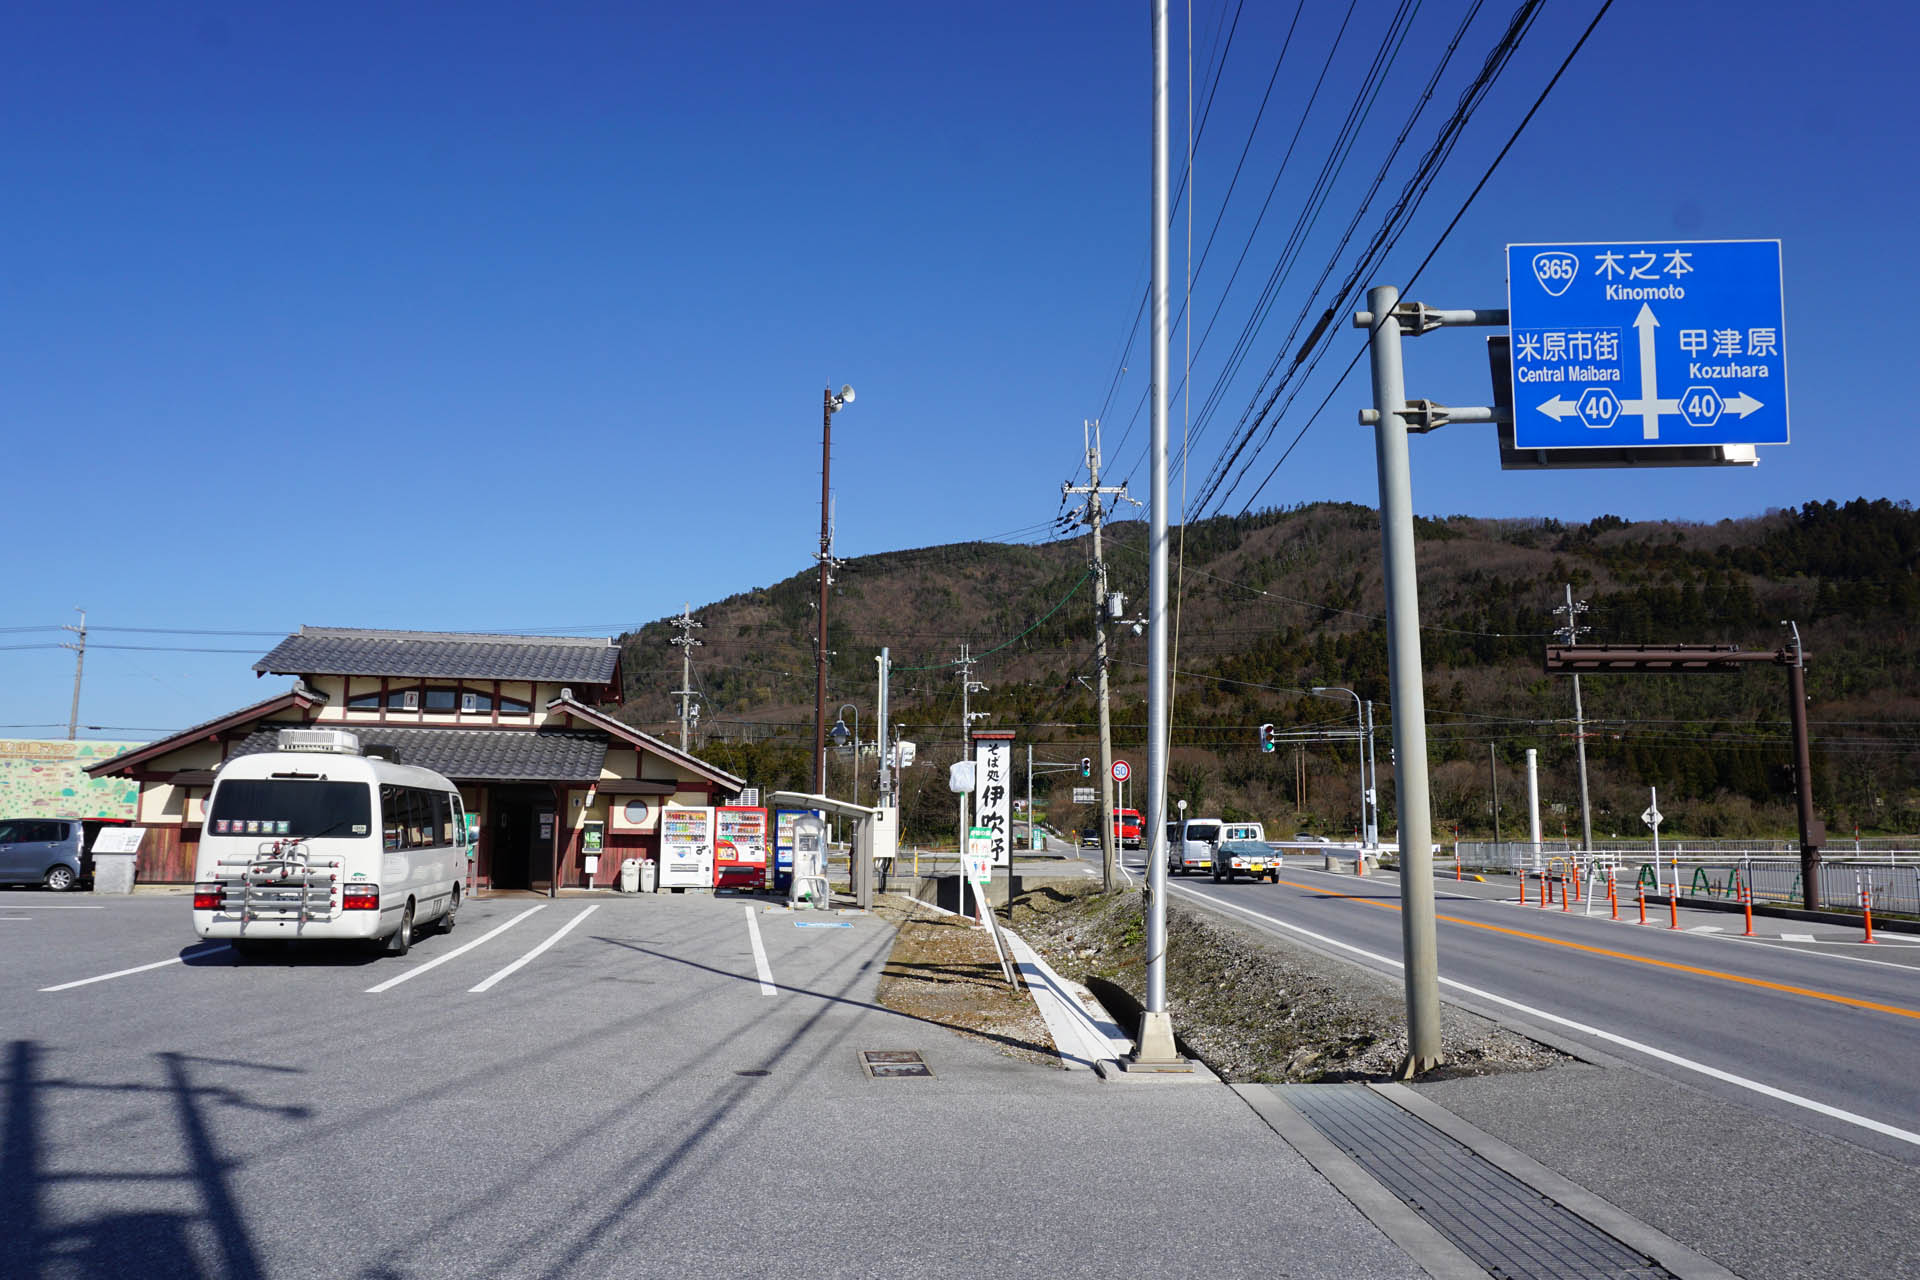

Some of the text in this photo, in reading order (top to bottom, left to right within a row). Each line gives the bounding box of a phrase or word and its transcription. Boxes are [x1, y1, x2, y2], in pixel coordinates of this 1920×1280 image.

[1539, 258, 1573, 279] 365
[1594, 249, 1694, 281] 木之本
[1605, 283, 1685, 301] Kinomoto
[1516, 331, 1619, 362] 米原市街
[1679, 328, 1778, 358] 甲津原
[1518, 365, 1621, 383] Central Maibara
[1689, 361, 1769, 379] Kozuhara
[1585, 396, 1613, 419] 40
[1687, 394, 1716, 418] 40
[1115, 765, 1128, 777] 50
